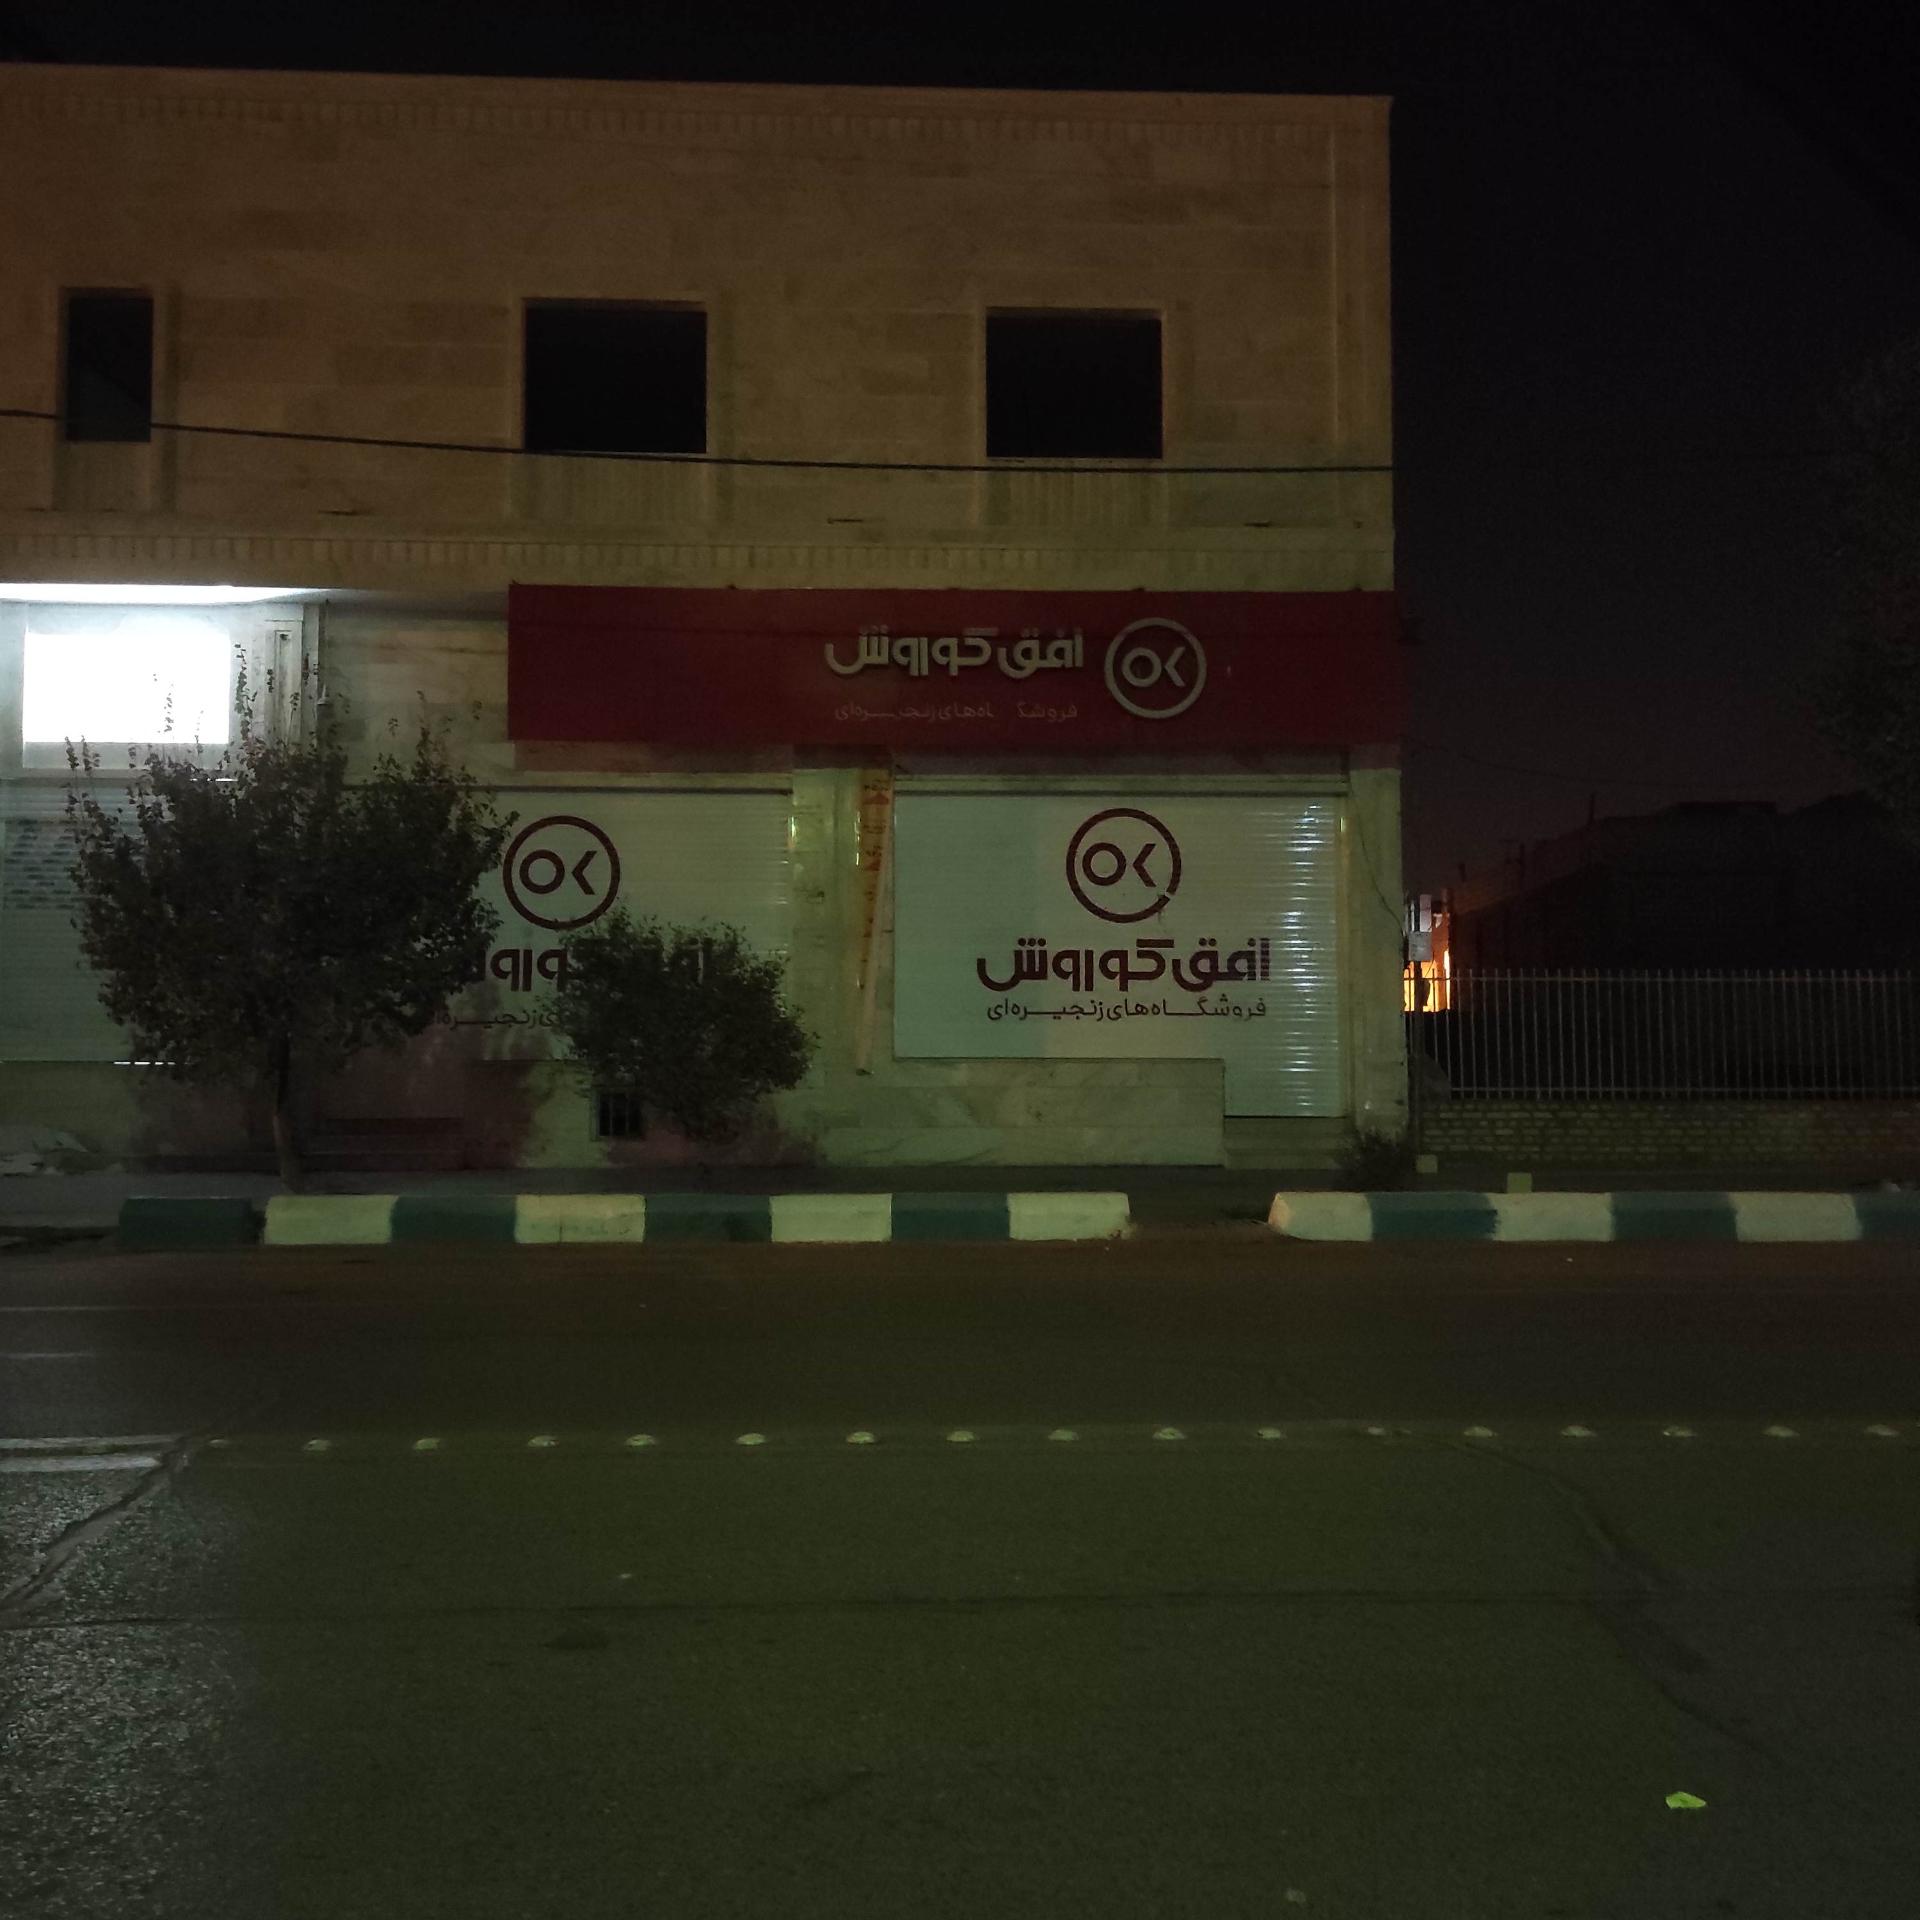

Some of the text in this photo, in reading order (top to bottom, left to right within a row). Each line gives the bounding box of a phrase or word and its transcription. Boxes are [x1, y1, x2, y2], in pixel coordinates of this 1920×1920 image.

[824, 624, 1085, 679] افق کوروش
[1120, 646, 1186, 688] OK
[519, 849, 597, 895] OK
[1082, 842, 1157, 888] OK
[976, 937, 1271, 993] افق کوروش
